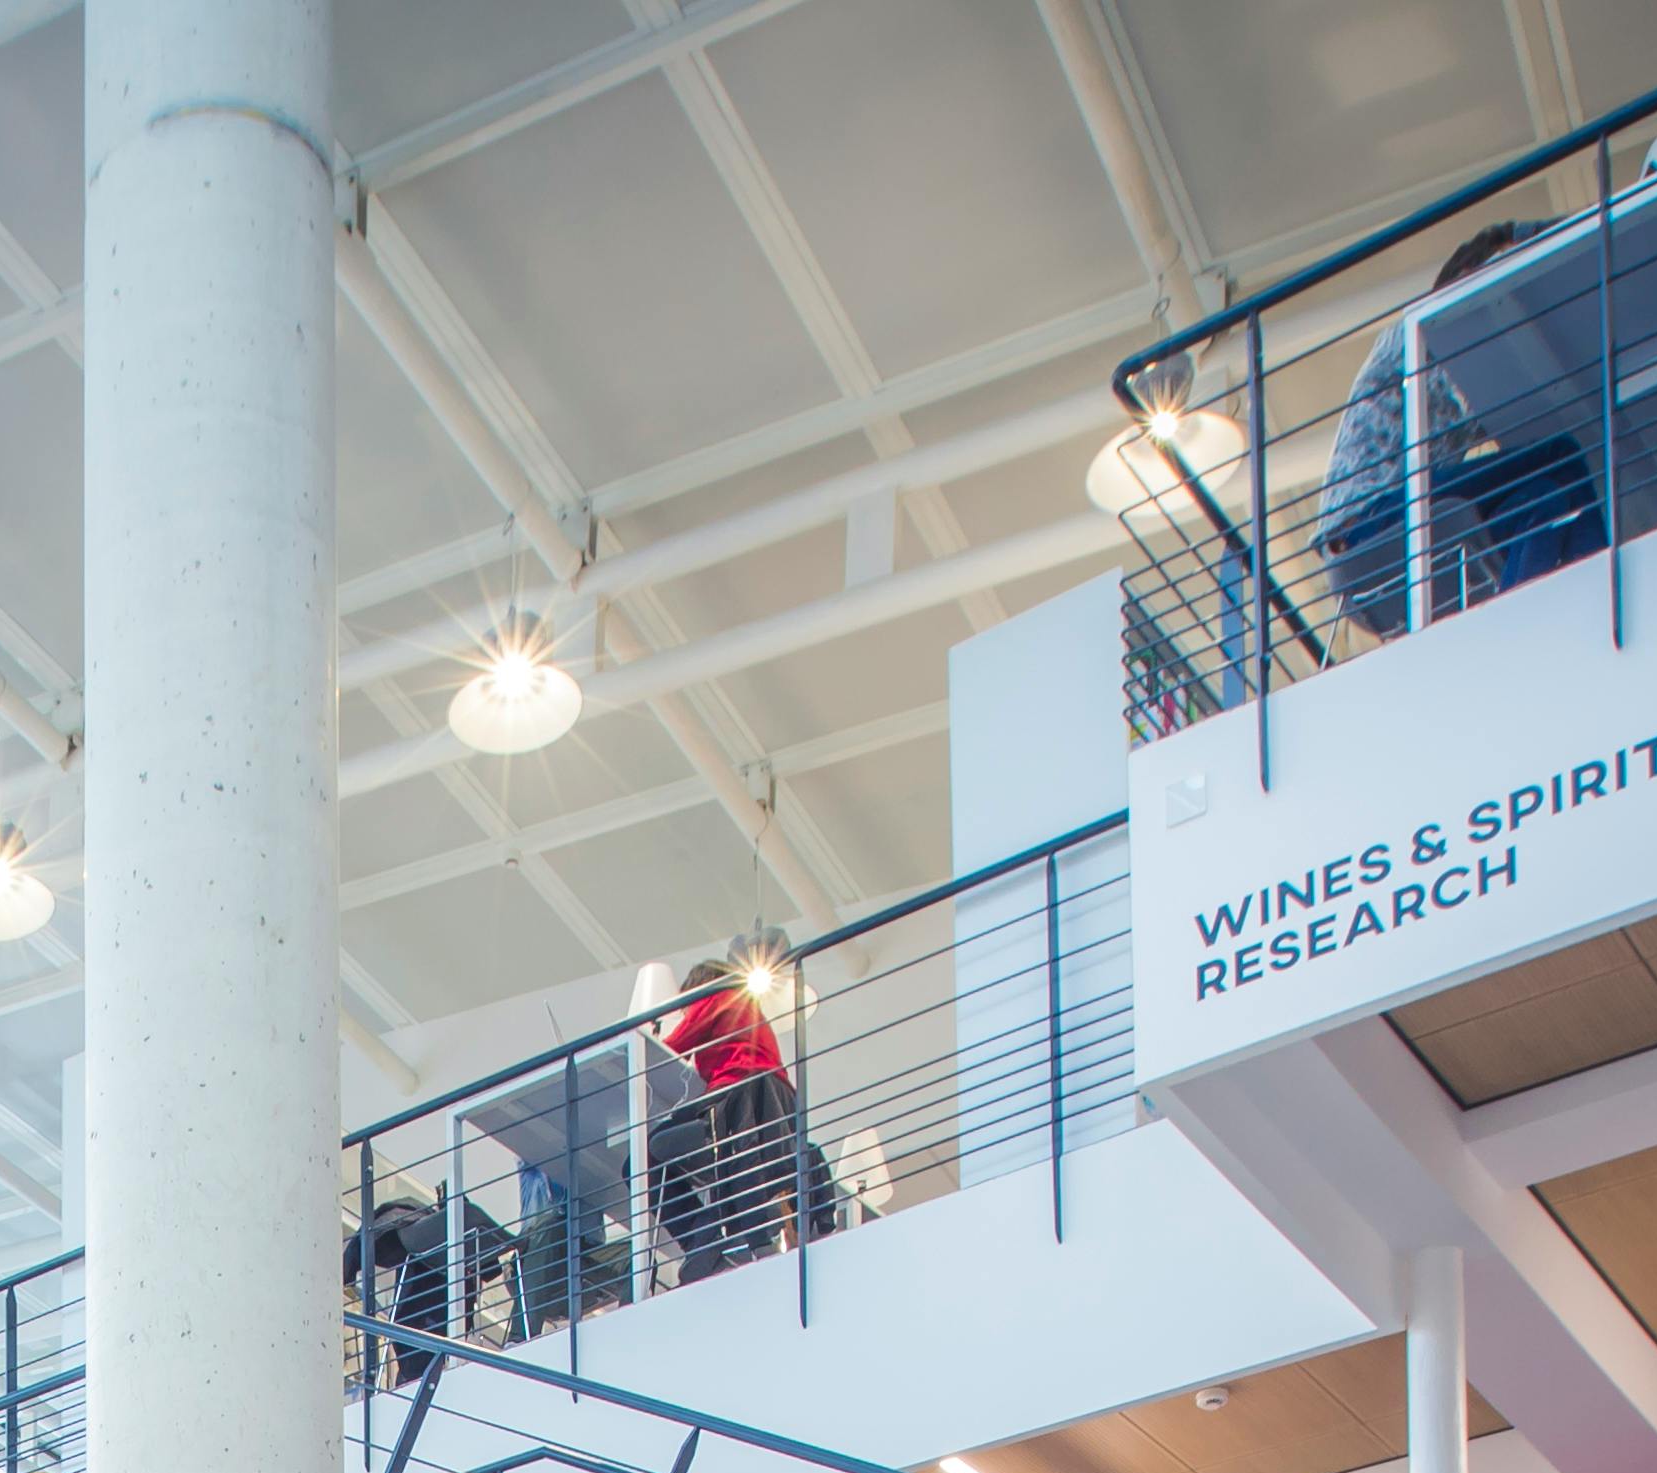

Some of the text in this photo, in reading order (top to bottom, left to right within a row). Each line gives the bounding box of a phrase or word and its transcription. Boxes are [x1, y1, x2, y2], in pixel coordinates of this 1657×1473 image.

[1194, 843, 1394, 948] WINES
[1412, 823, 1448, 866] &
[1195, 846, 1519, 1002] RESEARCH
